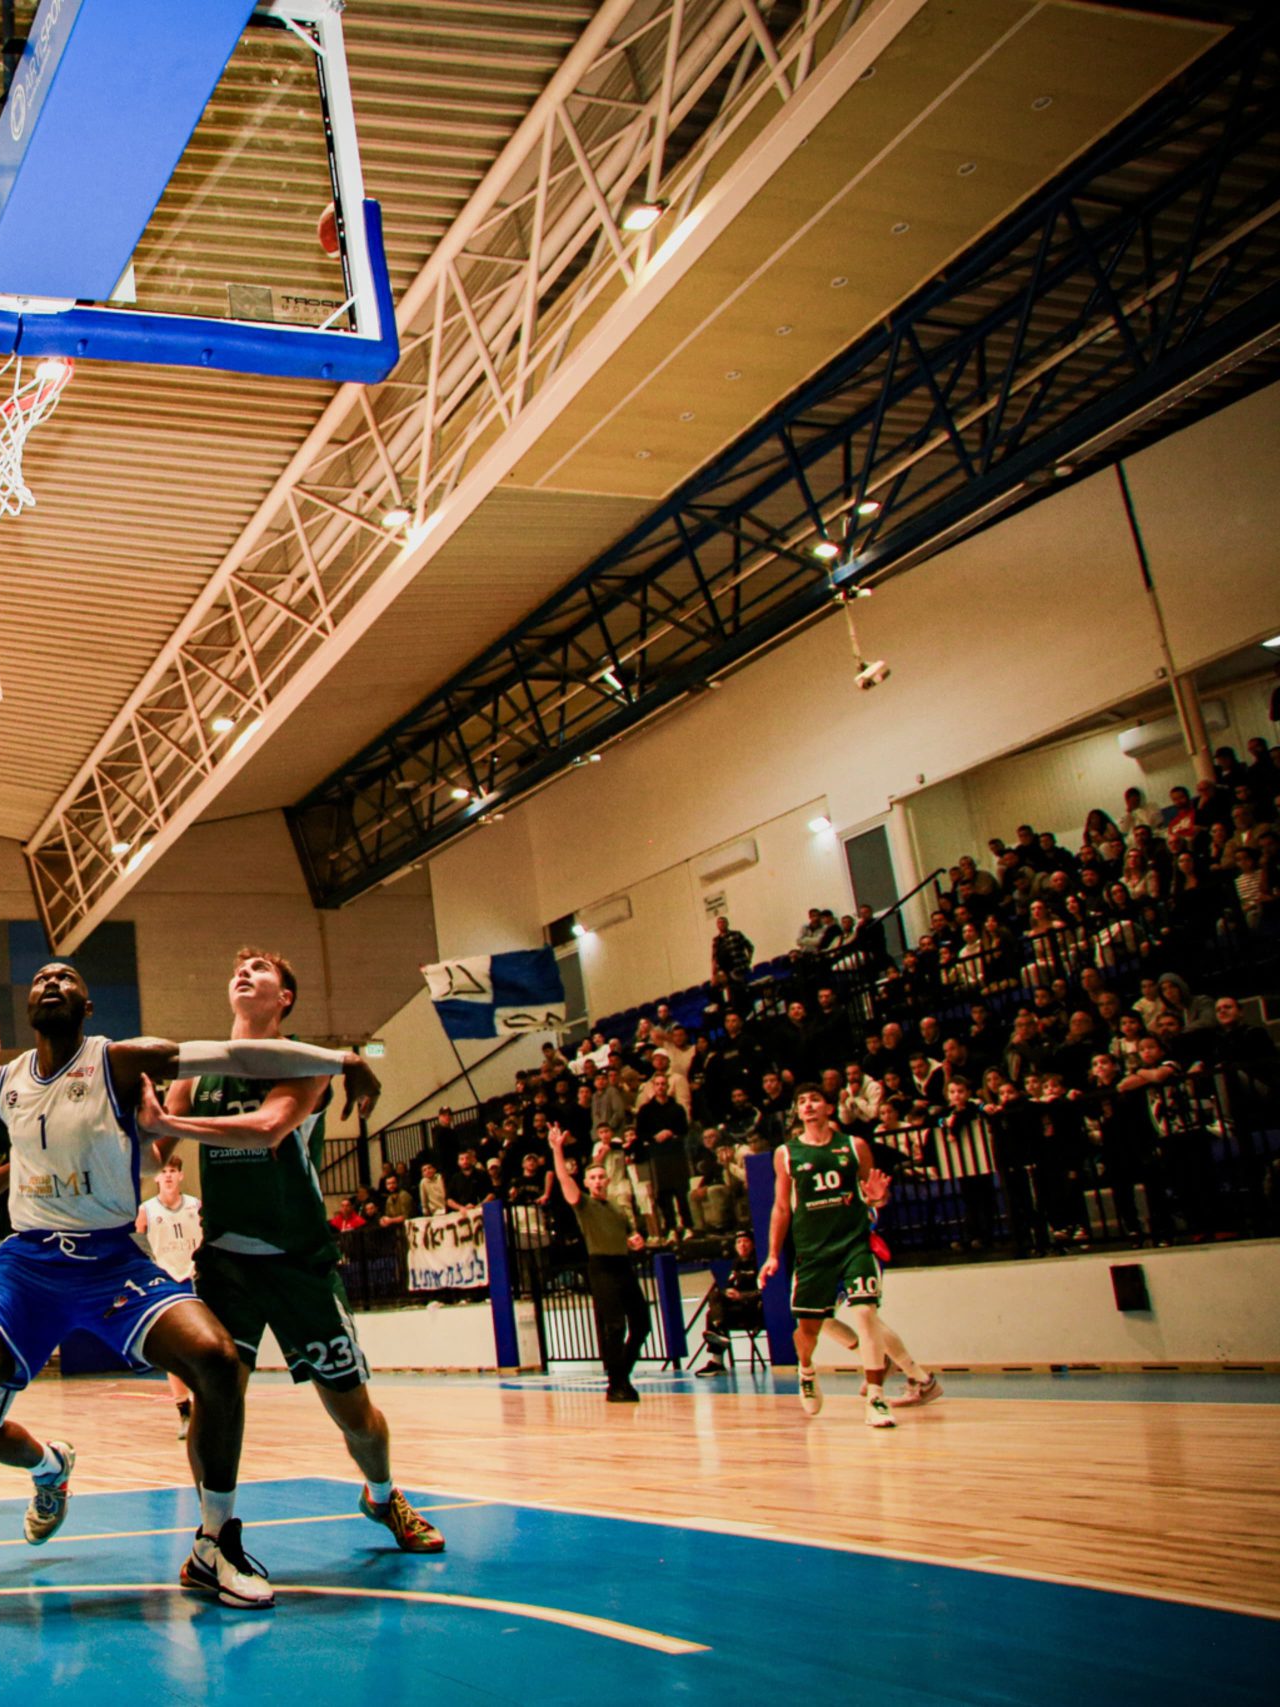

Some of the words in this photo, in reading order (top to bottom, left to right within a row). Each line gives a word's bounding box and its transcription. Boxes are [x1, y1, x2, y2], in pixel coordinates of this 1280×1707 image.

[37, 1113, 47, 1150] 1
[811, 1170, 842, 1192] 10
[173, 1222, 184, 1239] 11
[306, 1335, 353, 1371] 23
